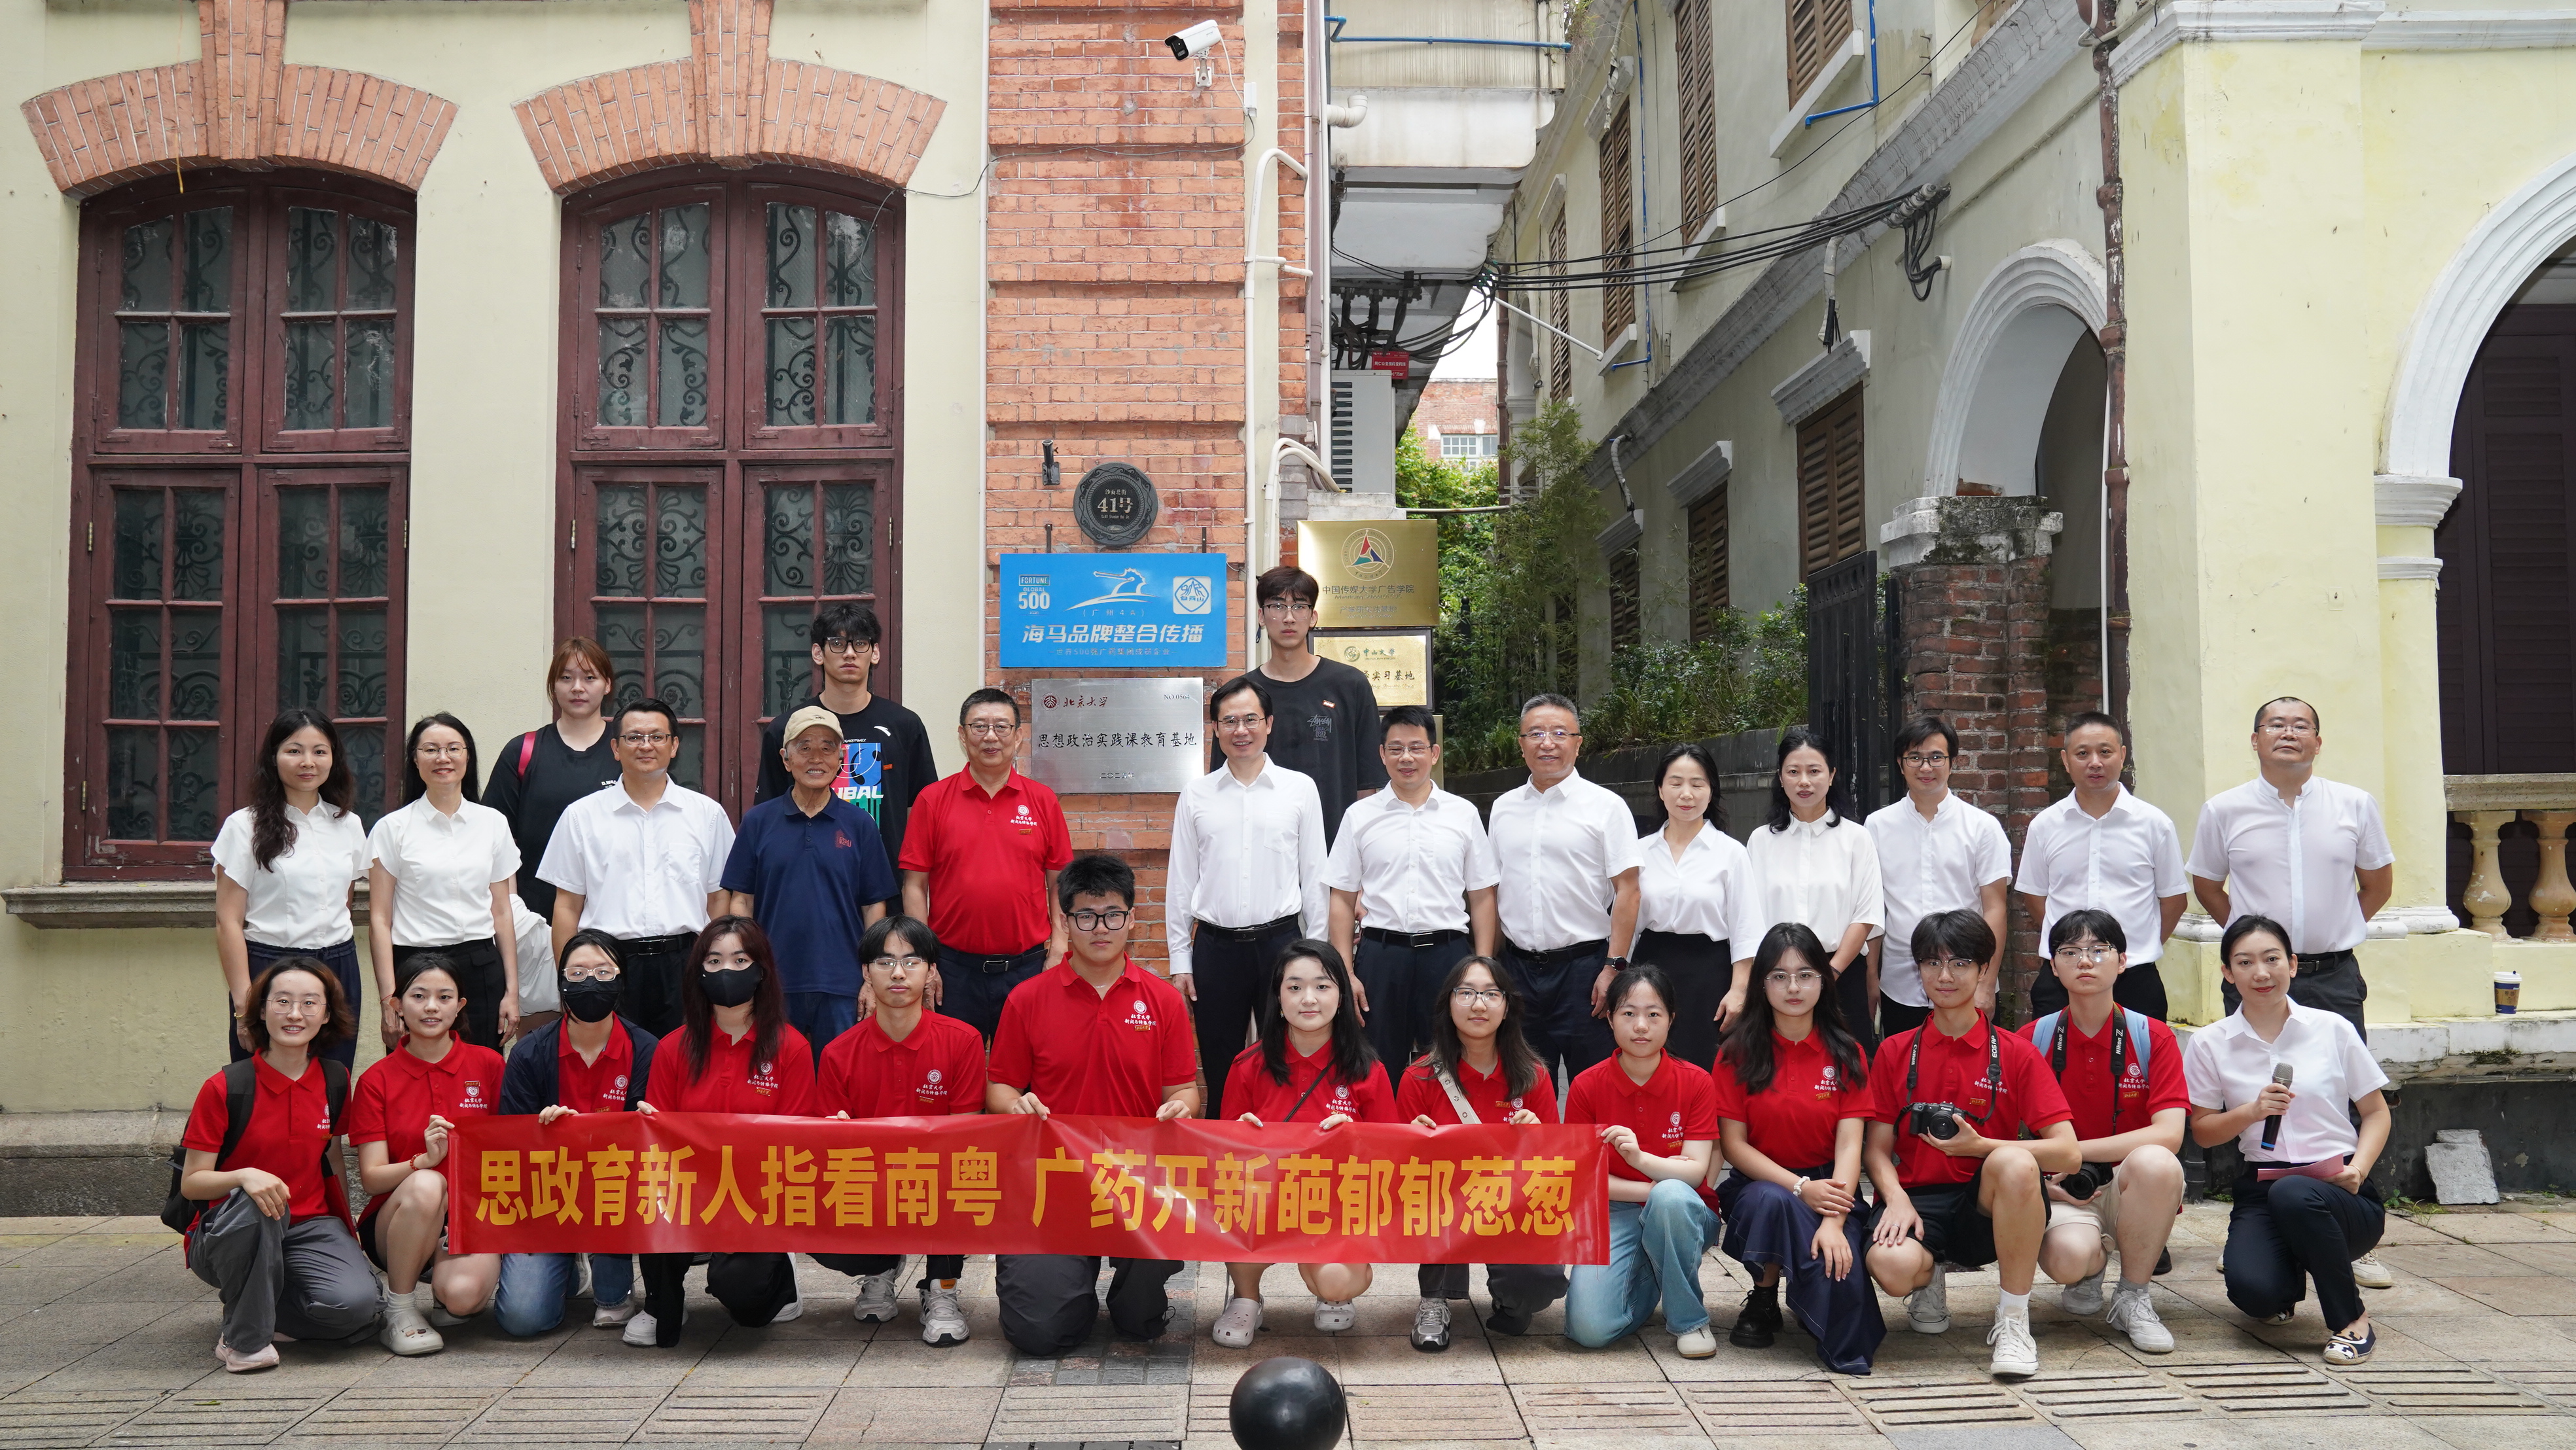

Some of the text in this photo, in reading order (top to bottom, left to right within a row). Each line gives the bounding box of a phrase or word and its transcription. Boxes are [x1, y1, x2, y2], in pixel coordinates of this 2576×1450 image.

[1097, 497, 1133, 513] 41号
[1322, 584, 1414, 594] 中国传媒大学广告学院
[1018, 592, 1050, 609] 500
[1022, 624, 1205, 643] 海马品牌整合传播
[1038, 732, 1197, 748] 思想政治实践课教育基地
[1991, 1035, 1997, 1045] RP
[476, 1143, 1576, 1237] 思政育新人指看南粤 广药开新葩郁郁葱葱
